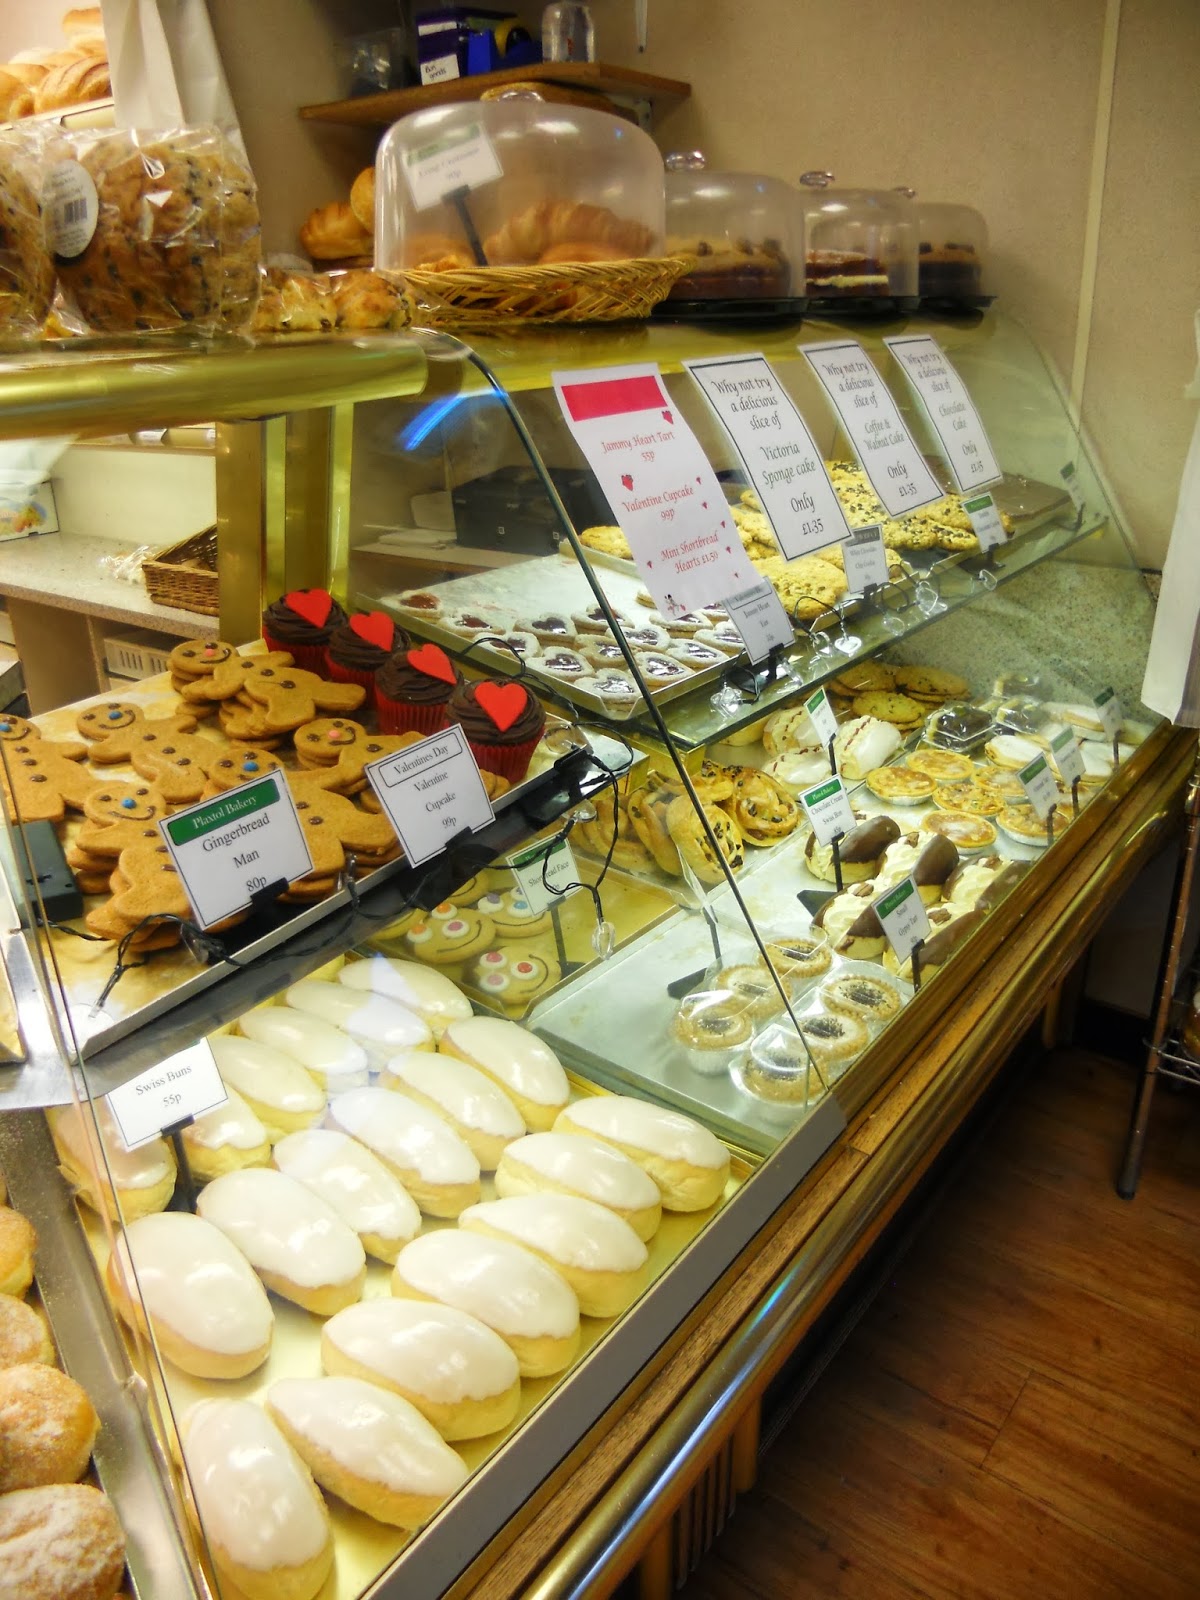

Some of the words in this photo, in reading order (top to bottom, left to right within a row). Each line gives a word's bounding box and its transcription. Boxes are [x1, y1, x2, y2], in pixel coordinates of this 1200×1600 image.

[822, 362, 845, 378] Why
[845, 362, 856, 373] not
[857, 361, 870, 375] try
[711, 379, 739, 396] Why
[739, 380, 756, 391] not
[756, 377, 772, 393] try
[839, 384, 845, 392] a
[731, 403, 738, 413] a
[739, 396, 778, 412] delicious
[870, 393, 878, 408] of
[750, 415, 770, 430] slice
[772, 411, 781, 429] of
[864, 419, 884, 434] Coffee
[601, 441, 632, 454] Jammy
[632, 435, 657, 446] Heart
[657, 431, 675, 441] Tart
[863, 434, 889, 450] Walnut
[889, 431, 905, 446] Cake
[962, 440, 978, 457] Only
[642, 451, 655, 462] 55p
[760, 442, 800, 461] Victoria
[762, 467, 795, 490] Sponge
[797, 457, 817, 476] cake
[887, 461, 908, 479] Only
[622, 498, 663, 512] Valentine
[662, 484, 694, 504] Cupcake
[899, 482, 918, 497] £1.35
[790, 492, 815, 513] Only
[660, 508, 675, 521] 99p
[802, 518, 824, 536] £1.35
[660, 544, 679, 562] Mini
[679, 532, 719, 557] Shortbread
[674, 556, 701, 575] Hearts
[701, 551, 719, 567] £1.50
[393, 753, 434, 775] Valentines
[433, 745, 449, 758] Day
[413, 770, 449, 792] Valentine
[192, 808, 225, 829] Plaxtol
[225, 794, 258, 815] Bakery
[425, 792, 457, 813] Cupcake
[442, 816, 457, 828] 99p
[202, 813, 271, 852] Gingerbread
[232, 850, 261, 868] Man
[246, 875, 267, 892] 80p
[528, 867, 556, 887] Shorread
[556, 861, 570, 871] Face
[135, 1076, 166, 1096] Swiss
[166, 1065, 192, 1082] Buns
[163, 1093, 182, 1107] 55p
